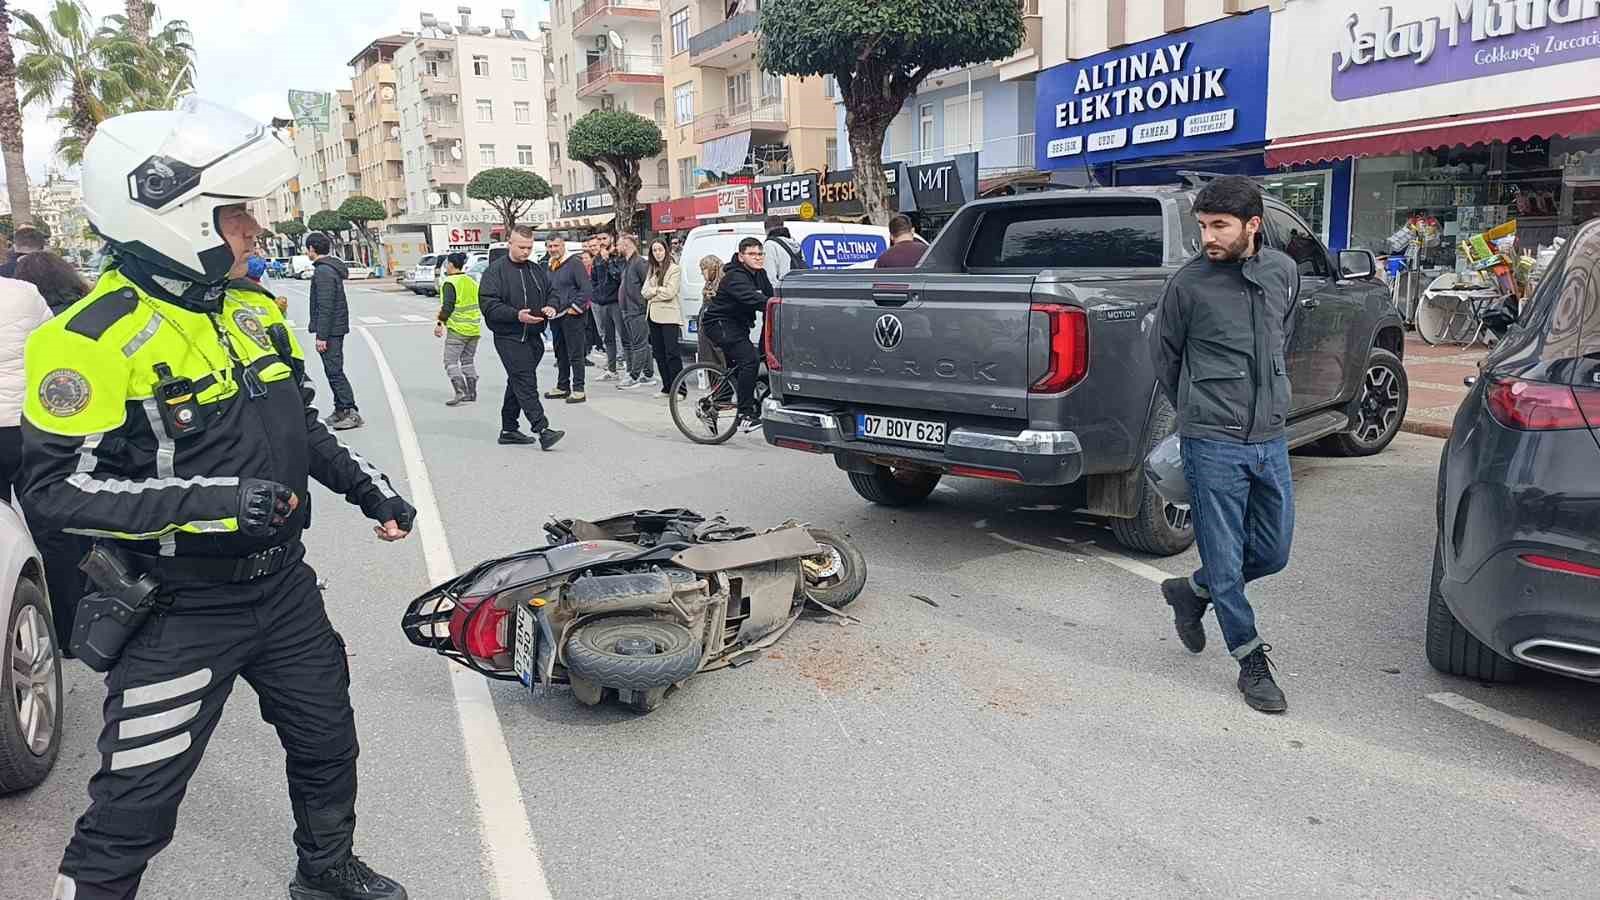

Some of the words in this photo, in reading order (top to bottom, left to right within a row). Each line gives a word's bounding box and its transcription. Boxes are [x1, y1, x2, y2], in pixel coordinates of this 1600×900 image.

[1074, 42, 1188, 94] ALTINAY
[1056, 66, 1225, 128] ELEKTRONİK
[1140, 125, 1169, 138] KAMERA
[837, 241, 877, 254] ALTINAY
[799, 358, 998, 382] AMAROK
[865, 416, 881, 435] 07
[887, 419, 912, 439] BOY
[916, 422, 944, 443] 623
